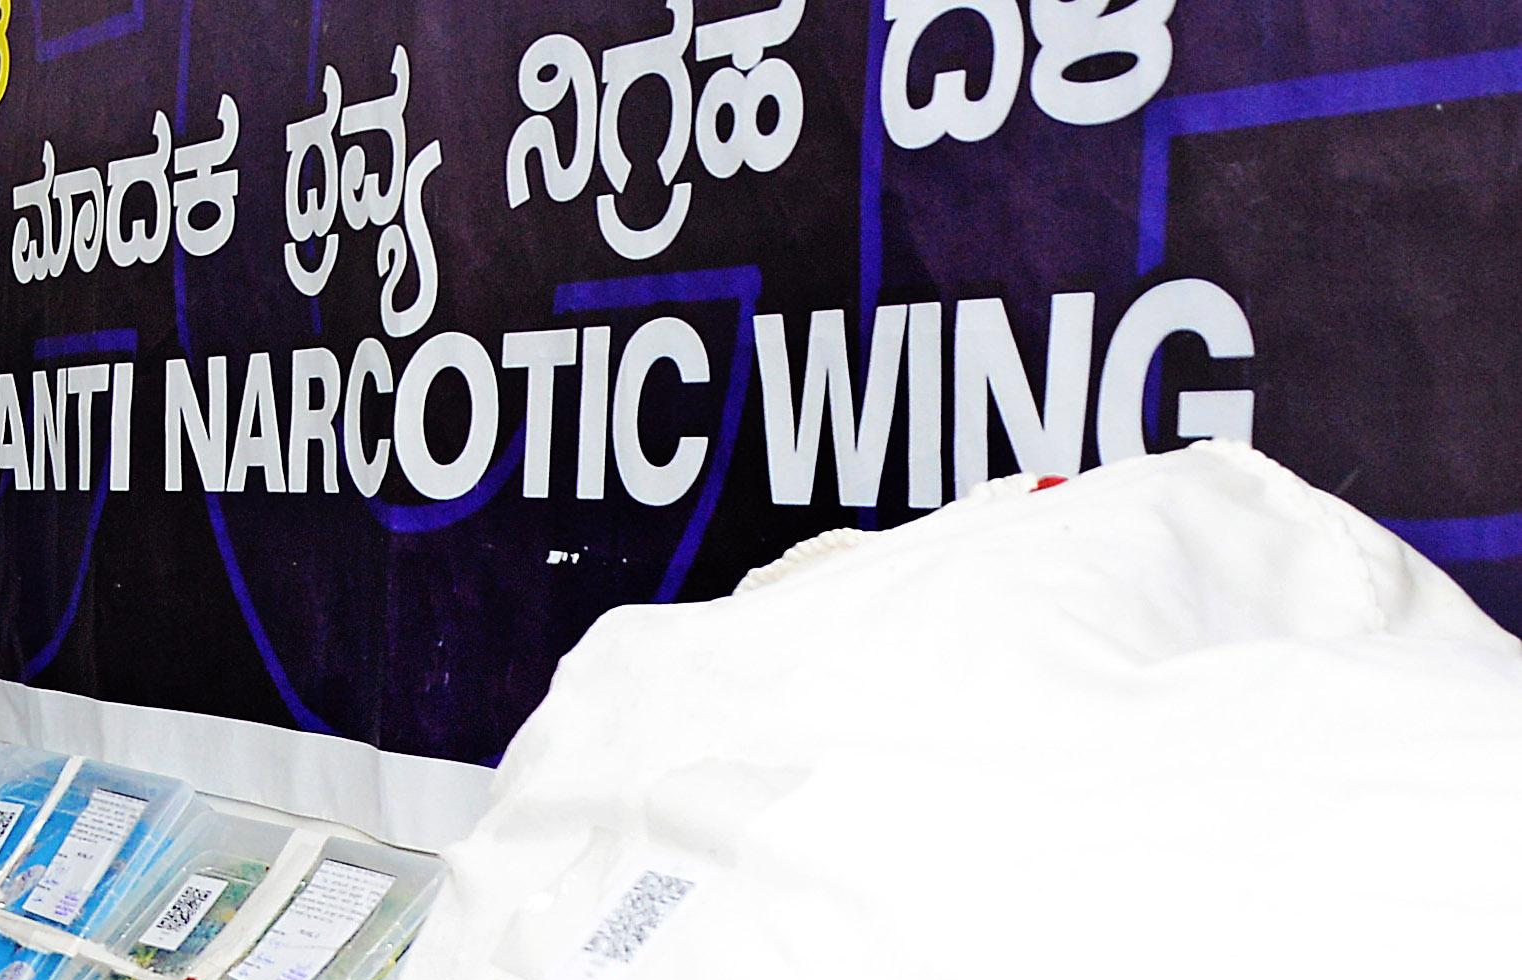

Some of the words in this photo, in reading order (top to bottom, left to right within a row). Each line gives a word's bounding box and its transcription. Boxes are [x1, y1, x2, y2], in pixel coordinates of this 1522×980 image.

[12, 94, 240, 284] ಮಾದಕ
[285, 45, 442, 338] ದ್ರವ್ಯ
[507, 0, 806, 260] ನಿಗ್ರಹ
[164, 316, 711, 507] NARCOTIC
[753, 279, 1255, 509] WING
